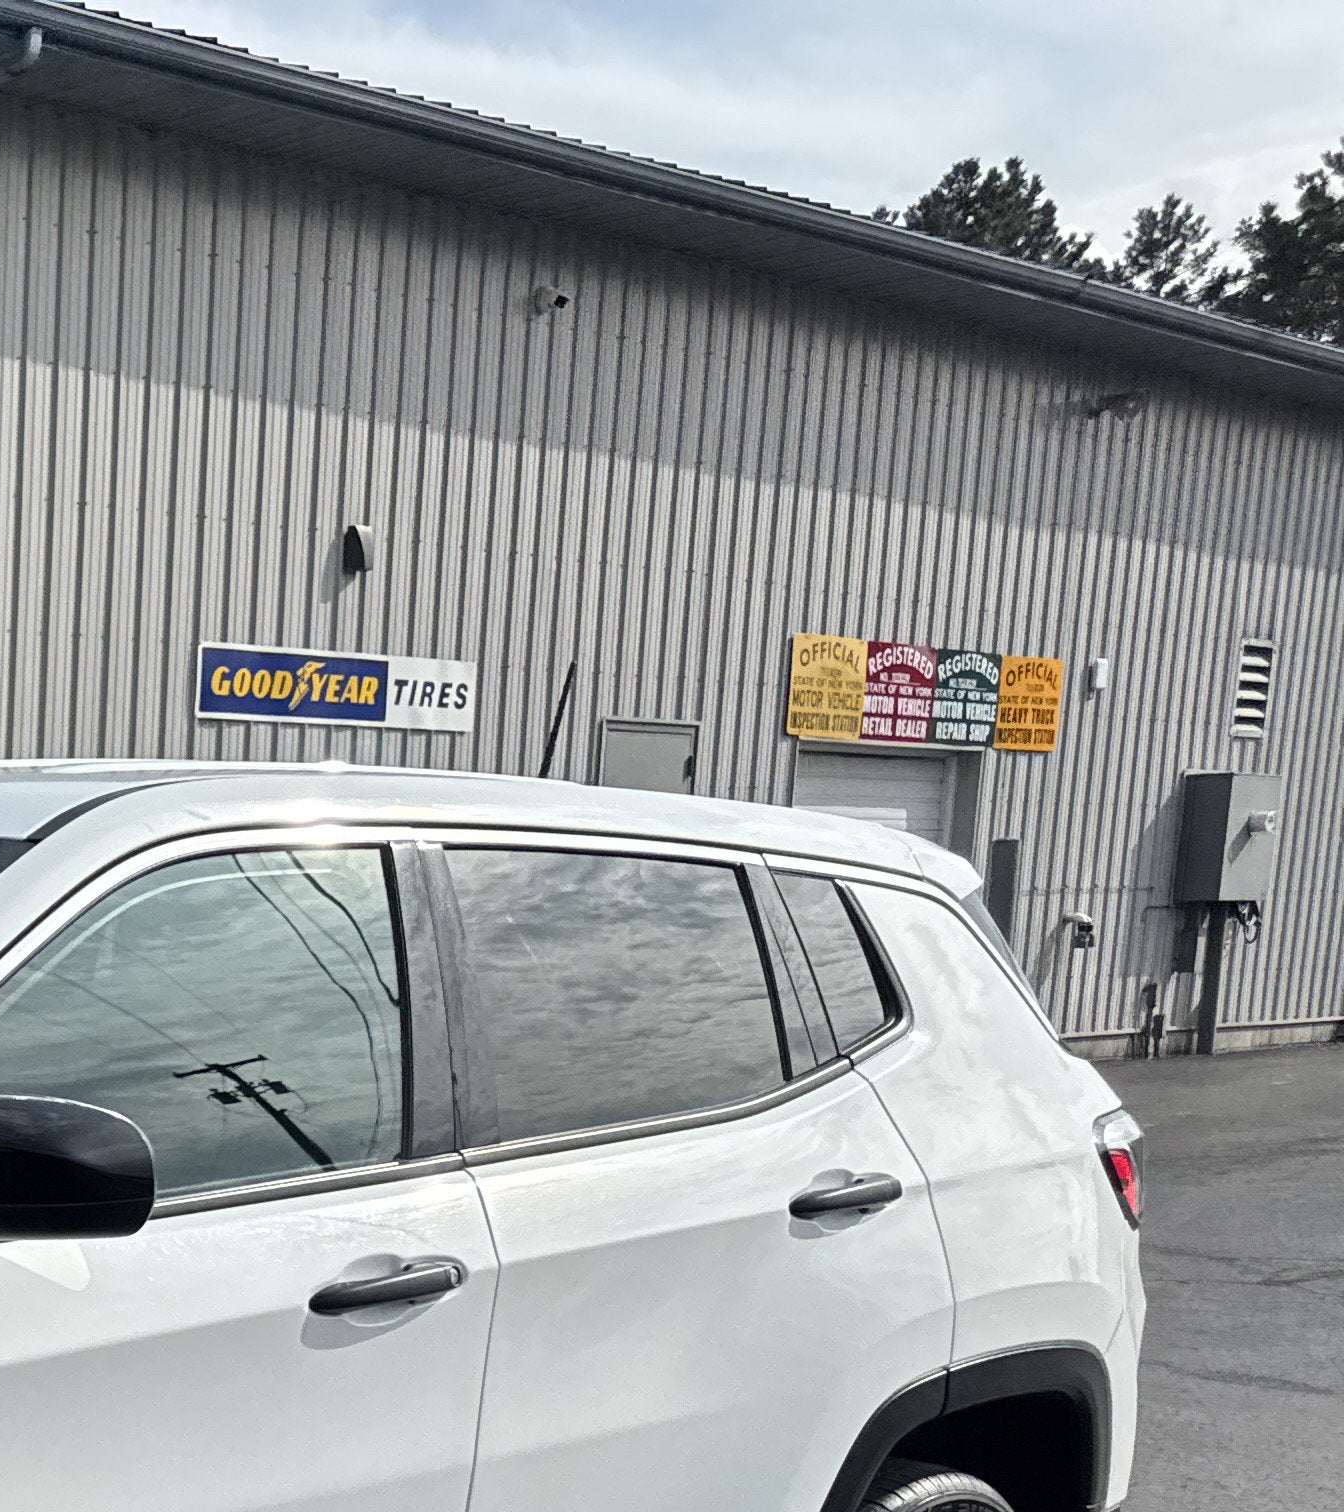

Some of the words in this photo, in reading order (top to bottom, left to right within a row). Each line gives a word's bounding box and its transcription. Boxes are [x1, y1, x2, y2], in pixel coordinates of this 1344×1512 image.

[799, 641, 860, 674] OFFICIAL
[868, 645, 934, 680] REGISTERED
[937, 652, 1000, 686] REGISTERED
[211, 664, 379, 706] GOODYEAR
[393, 678, 469, 710] TIRES
[864, 682, 886, 694] STATE
[888, 683, 898, 694] OF
[1005, 661, 1058, 691] OFFICIAL
[792, 688, 824, 709] MOTOR
[827, 691, 862, 712] VEHICLE
[934, 687, 956, 699] STATE
[957, 689, 967, 700] OF
[862, 694, 895, 715] MOTOR
[896, 696, 932, 718] VEHICLE
[932, 700, 964, 720] MOTOR
[965, 702, 997, 723] VEHICLE
[999, 706, 1029, 725] HEAVY
[1031, 707, 1055, 725] TRUCK
[861, 716, 893, 737] RETAIL
[895, 718, 928, 739] DEALER
[935, 721, 968, 740] REPAIR
[968, 723, 991, 743] SHOP
